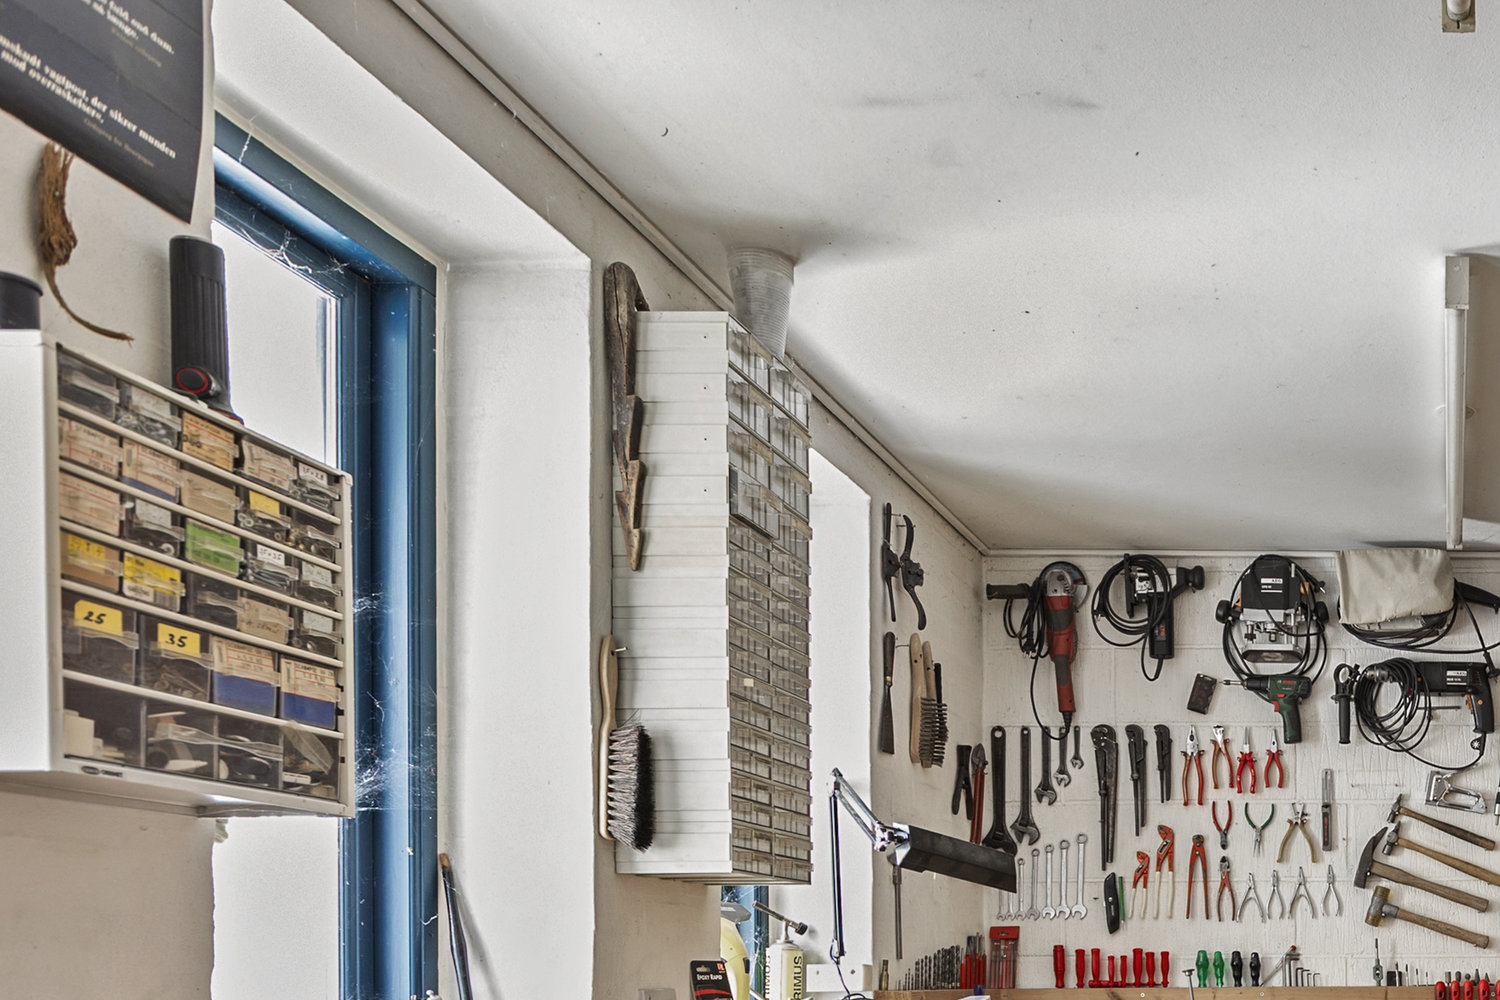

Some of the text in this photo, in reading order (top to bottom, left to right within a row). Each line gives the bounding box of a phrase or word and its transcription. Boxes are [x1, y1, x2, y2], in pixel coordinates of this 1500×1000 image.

[91, 96, 107, 112] der
[109, 108, 138, 133] sikrer
[139, 129, 177, 159] munden
[83, 611, 106, 624] 25
[165, 633, 188, 648] 35
